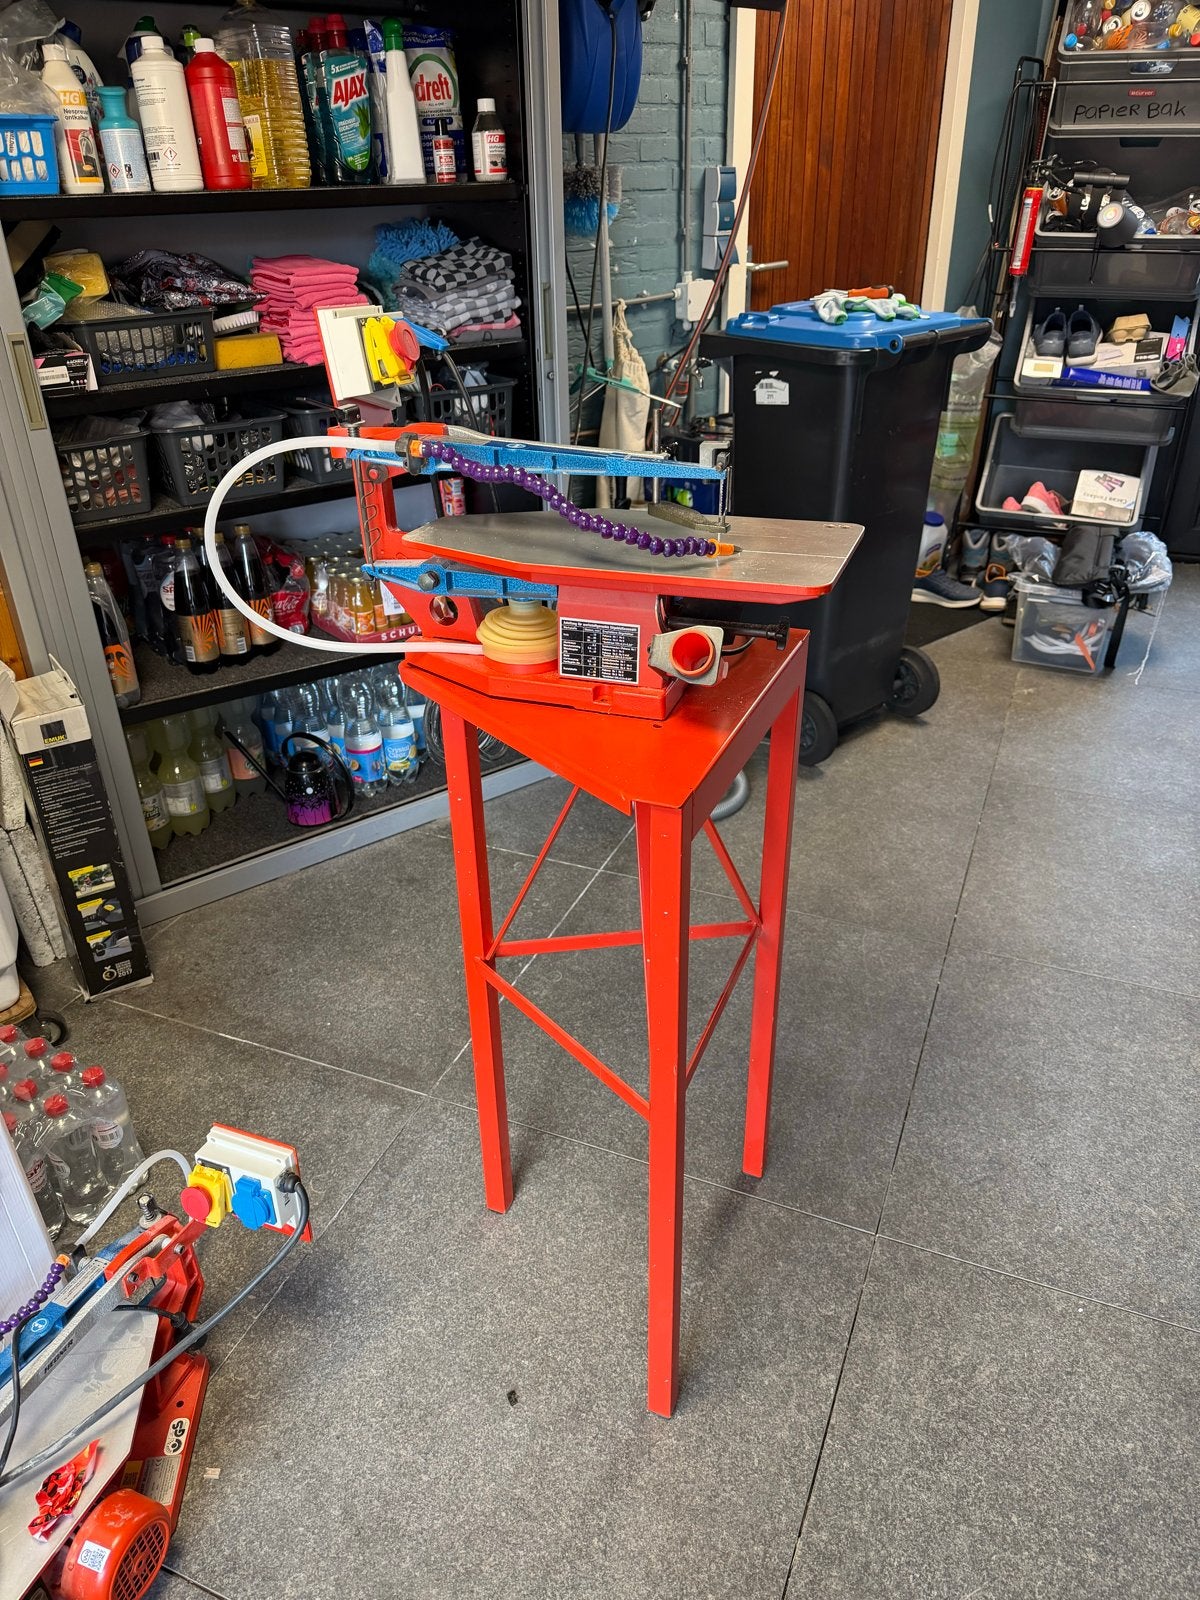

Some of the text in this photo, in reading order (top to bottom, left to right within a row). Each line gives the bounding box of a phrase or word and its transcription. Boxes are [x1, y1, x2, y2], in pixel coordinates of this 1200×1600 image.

[333, 72, 367, 107] AJAX
[414, 73, 452, 101] dreft
[60, 91, 80, 105] HG
[487, 135, 499, 143] HG
[162, 585, 174, 594] SP
[44, 734, 66, 745] EMUK
[386, 744, 410, 755] Crystal
[172, 1420, 186, 1438] GS
